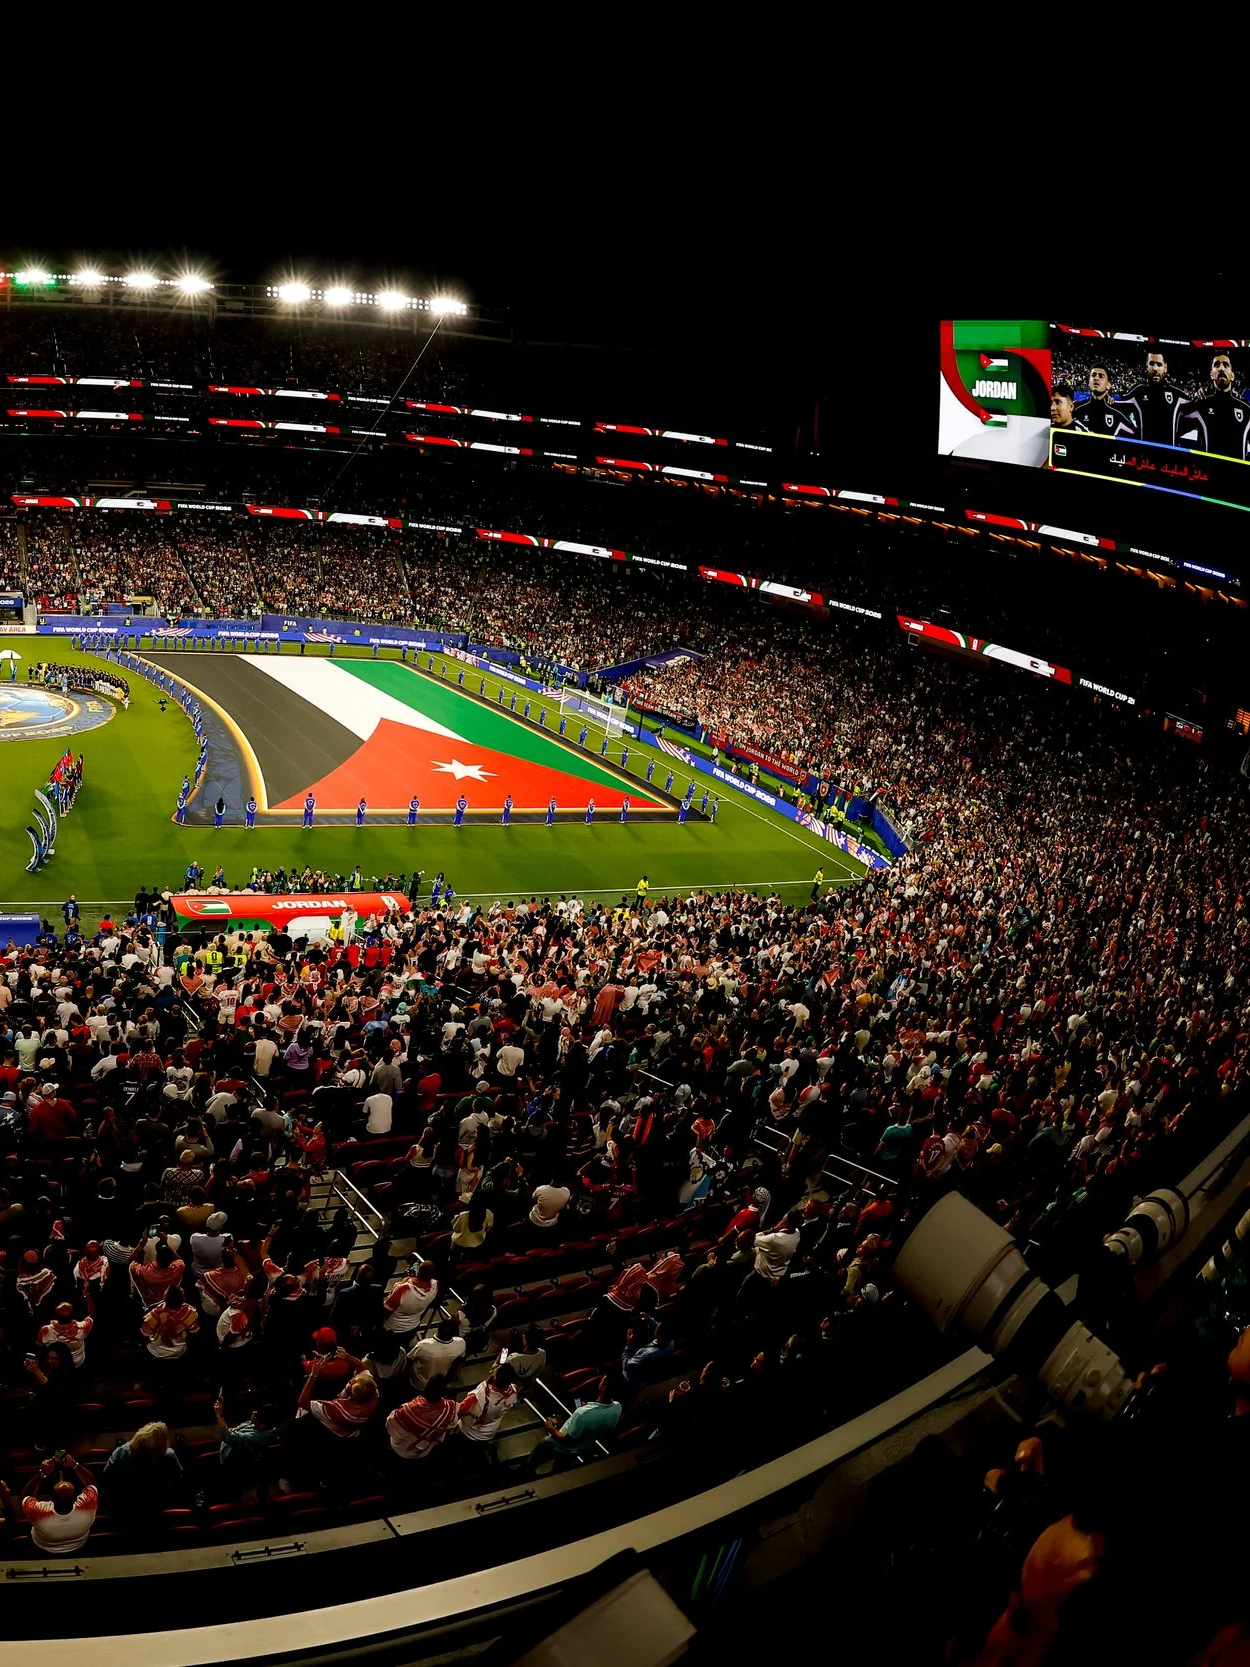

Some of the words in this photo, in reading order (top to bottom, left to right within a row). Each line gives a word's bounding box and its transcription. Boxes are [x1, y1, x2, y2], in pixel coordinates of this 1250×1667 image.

[972, 380, 1017, 400] JORDAN
[642, 557, 661, 566] WORLD
[829, 599, 839, 608] FIFA
[838, 602, 856, 612] WORLD
[855, 606, 866, 615] CUP
[864, 609, 882, 619] 2026
[1079, 678, 1093, 689] FIFA
[1093, 682, 1115, 698] WORLD
[1114, 691, 1128, 702] CUP
[746, 745, 765, 758] JORDAN
[765, 754, 771, 762] TO
[772, 758, 781, 767] THE
[781, 763, 799, 776] WORLD
[713, 766, 725, 780] FIFA
[724, 772, 745, 790] WORLD
[744, 782, 756, 796] CUP
[755, 788, 776, 807] 2026
[271, 900, 346, 910] JORDAN
[125, 1092, 136, 1106] 7
